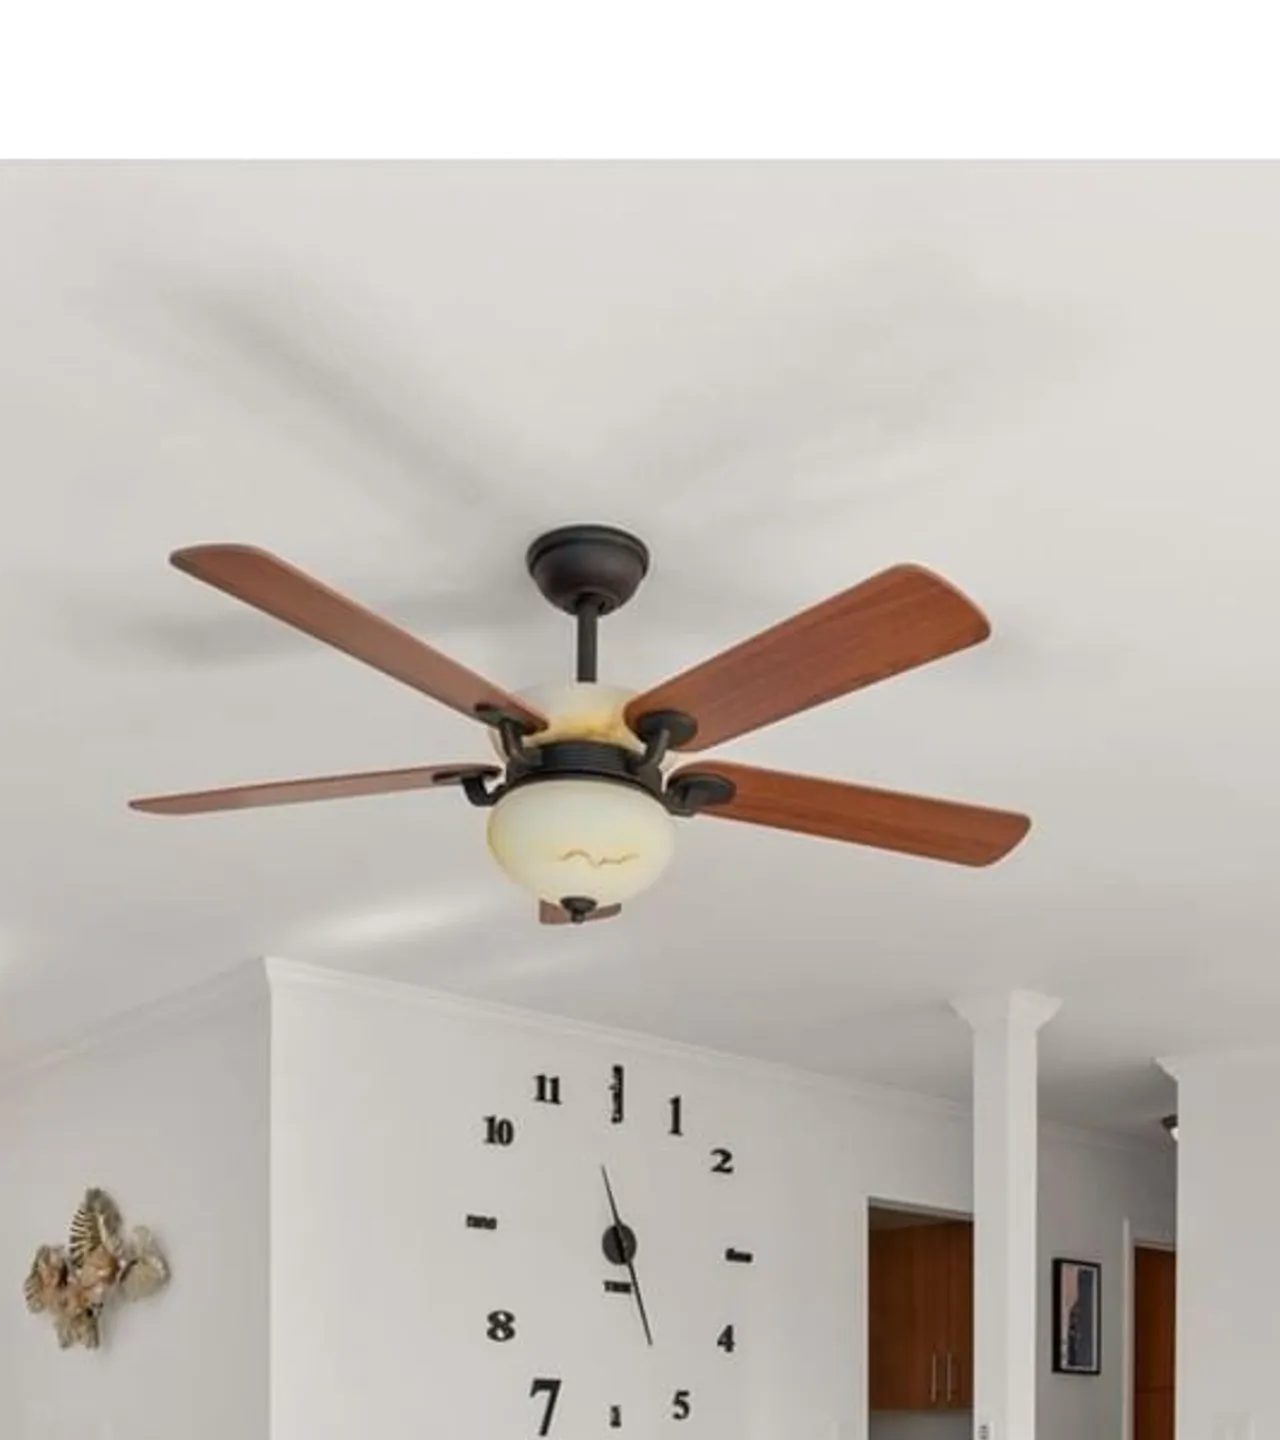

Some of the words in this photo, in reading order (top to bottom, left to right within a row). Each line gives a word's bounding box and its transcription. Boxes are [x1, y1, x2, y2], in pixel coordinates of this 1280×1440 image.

[533, 1073, 561, 1104] 11
[484, 1115, 514, 1146] 10
[710, 1148, 734, 1174] 2
[486, 1310, 516, 1342] 8
[716, 1324, 735, 1353] 4
[530, 1378, 562, 1437] 7
[672, 1390, 690, 1420] 5
